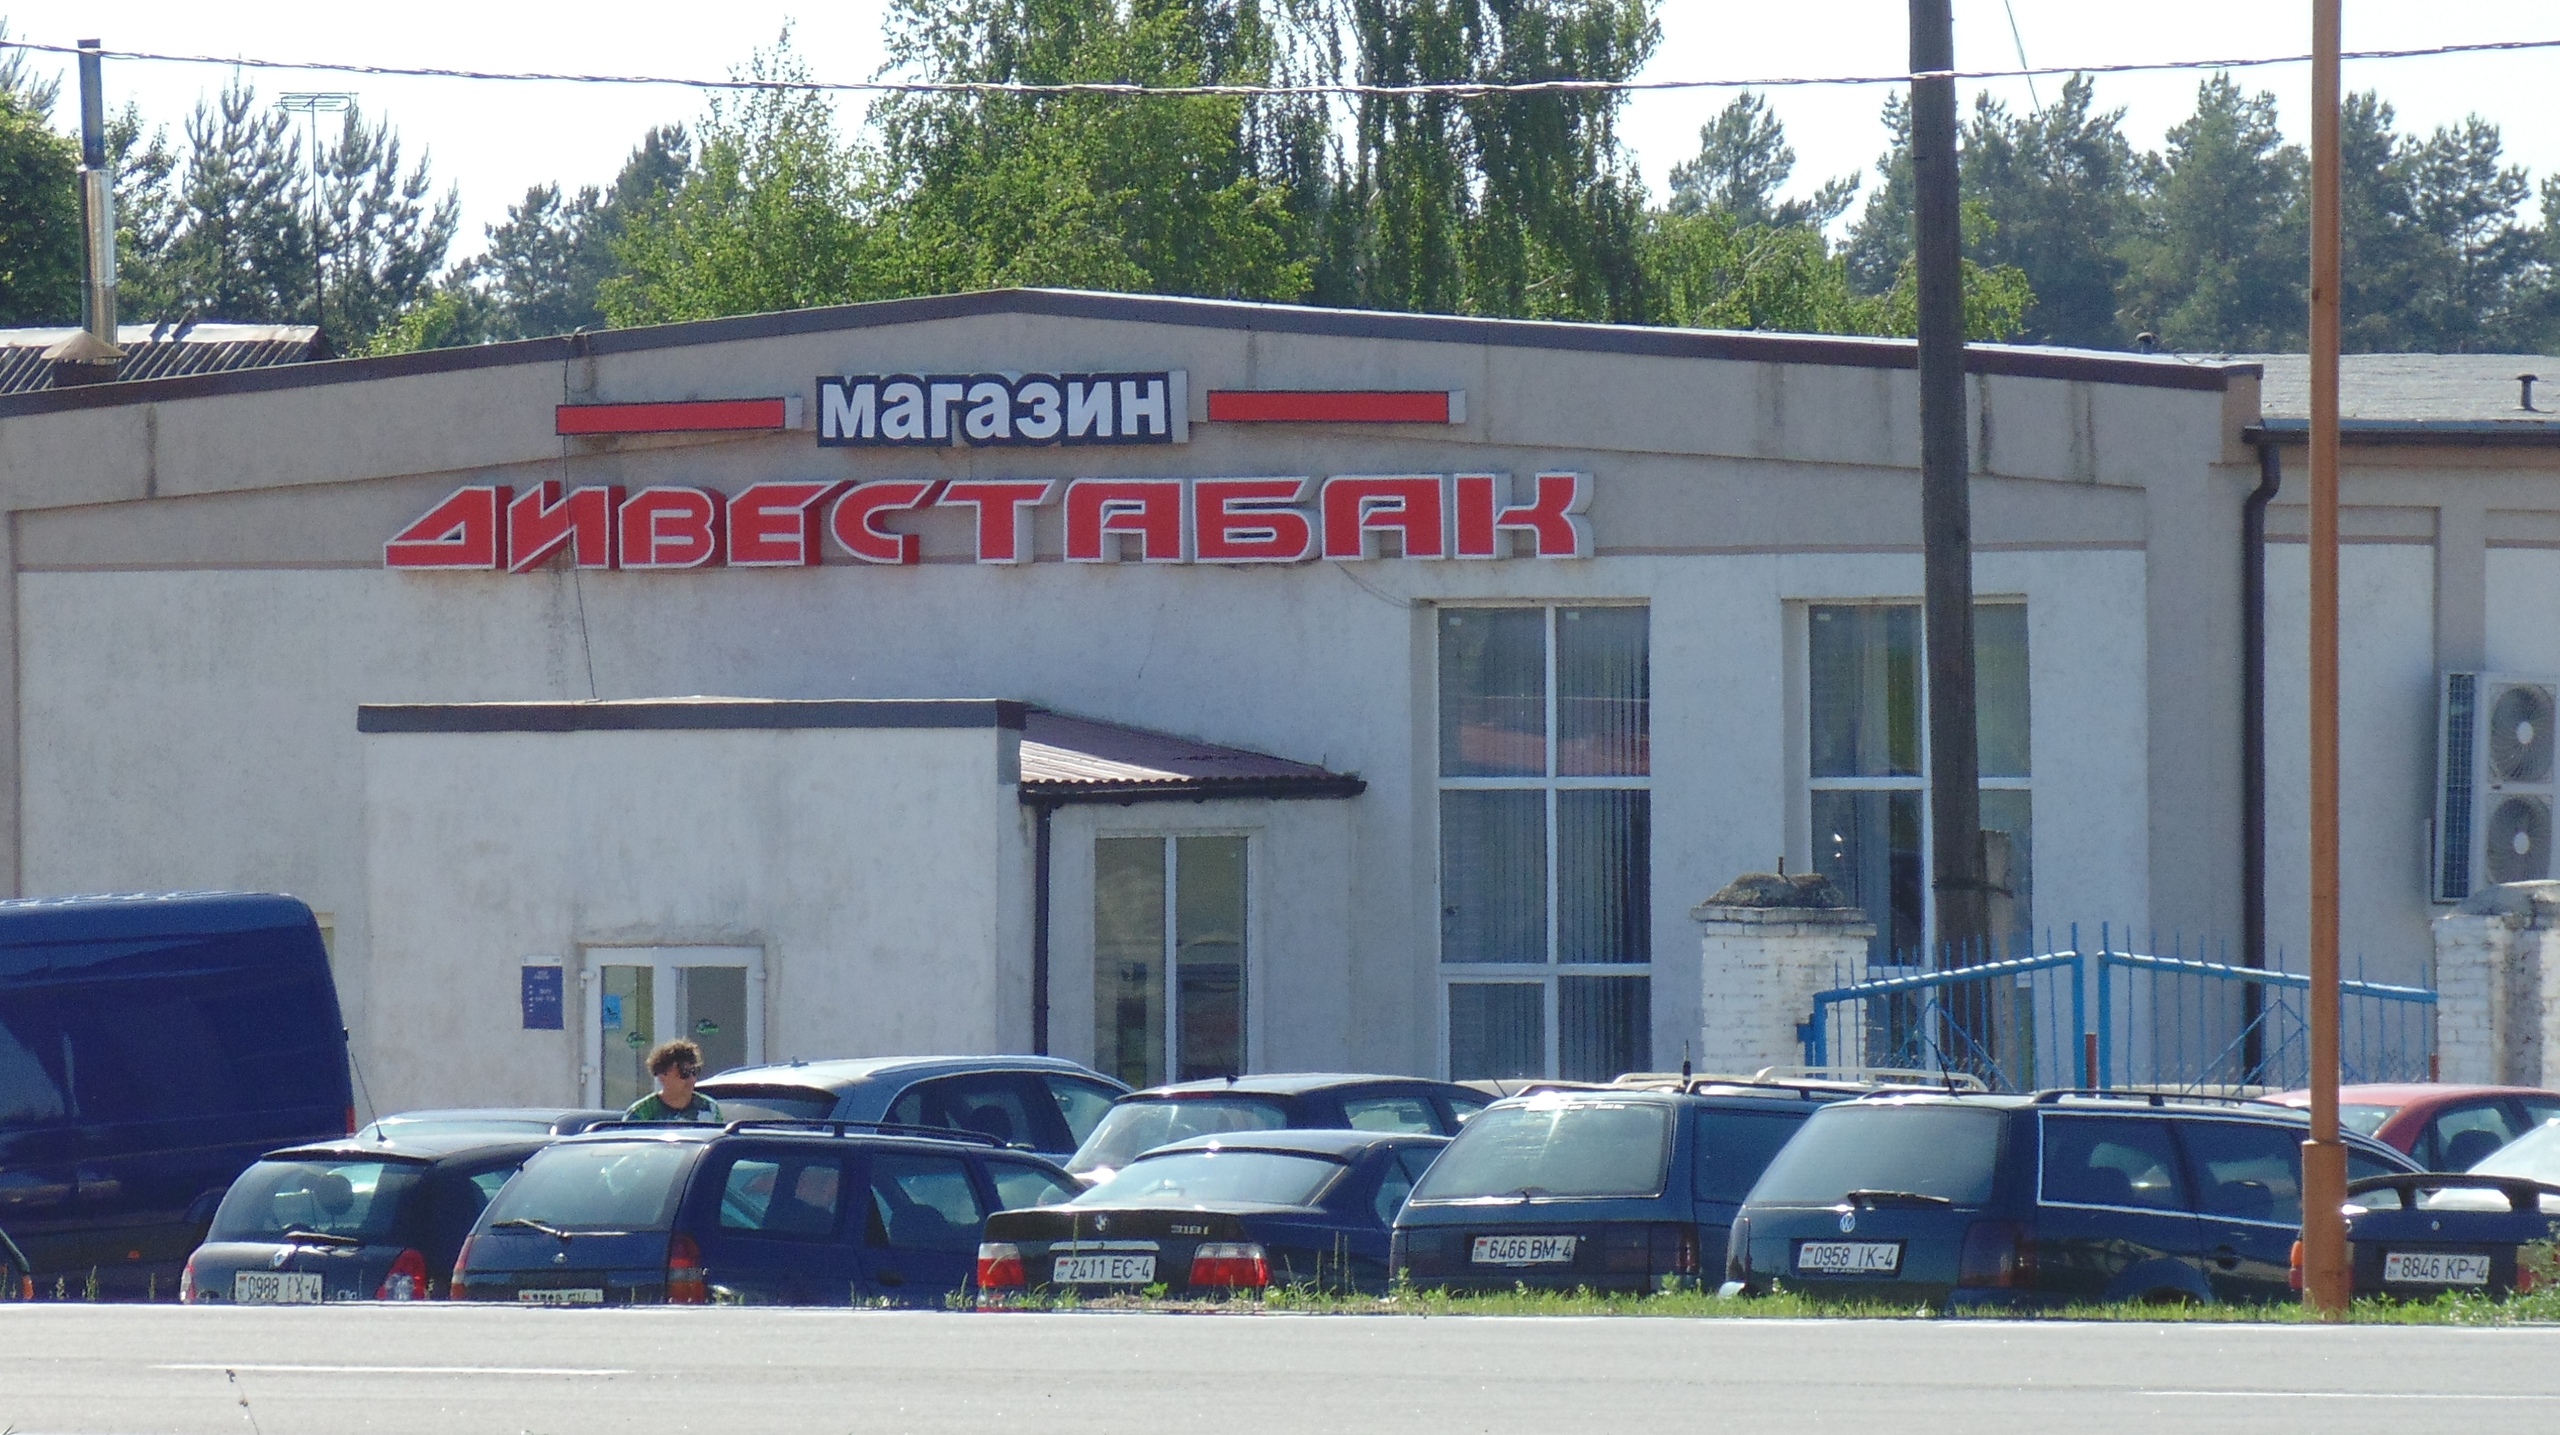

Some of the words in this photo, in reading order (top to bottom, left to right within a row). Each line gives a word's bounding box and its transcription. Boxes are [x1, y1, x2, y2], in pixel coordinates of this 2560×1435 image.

[822, 379, 1167, 442] магазин
[1489, 1239, 1527, 1259] 6466
[1530, 1239, 1572, 1260] BM-4
[1813, 1245, 1851, 1266] 0958
[1857, 1246, 1894, 1267] IK-4
[1069, 1258, 1105, 1280] 2411
[1111, 1258, 1151, 1280] EC-4
[2401, 1256, 2441, 1279] 8846
[2445, 1258, 2487, 1280] KP-4
[247, 1275, 280, 1300] 0988
